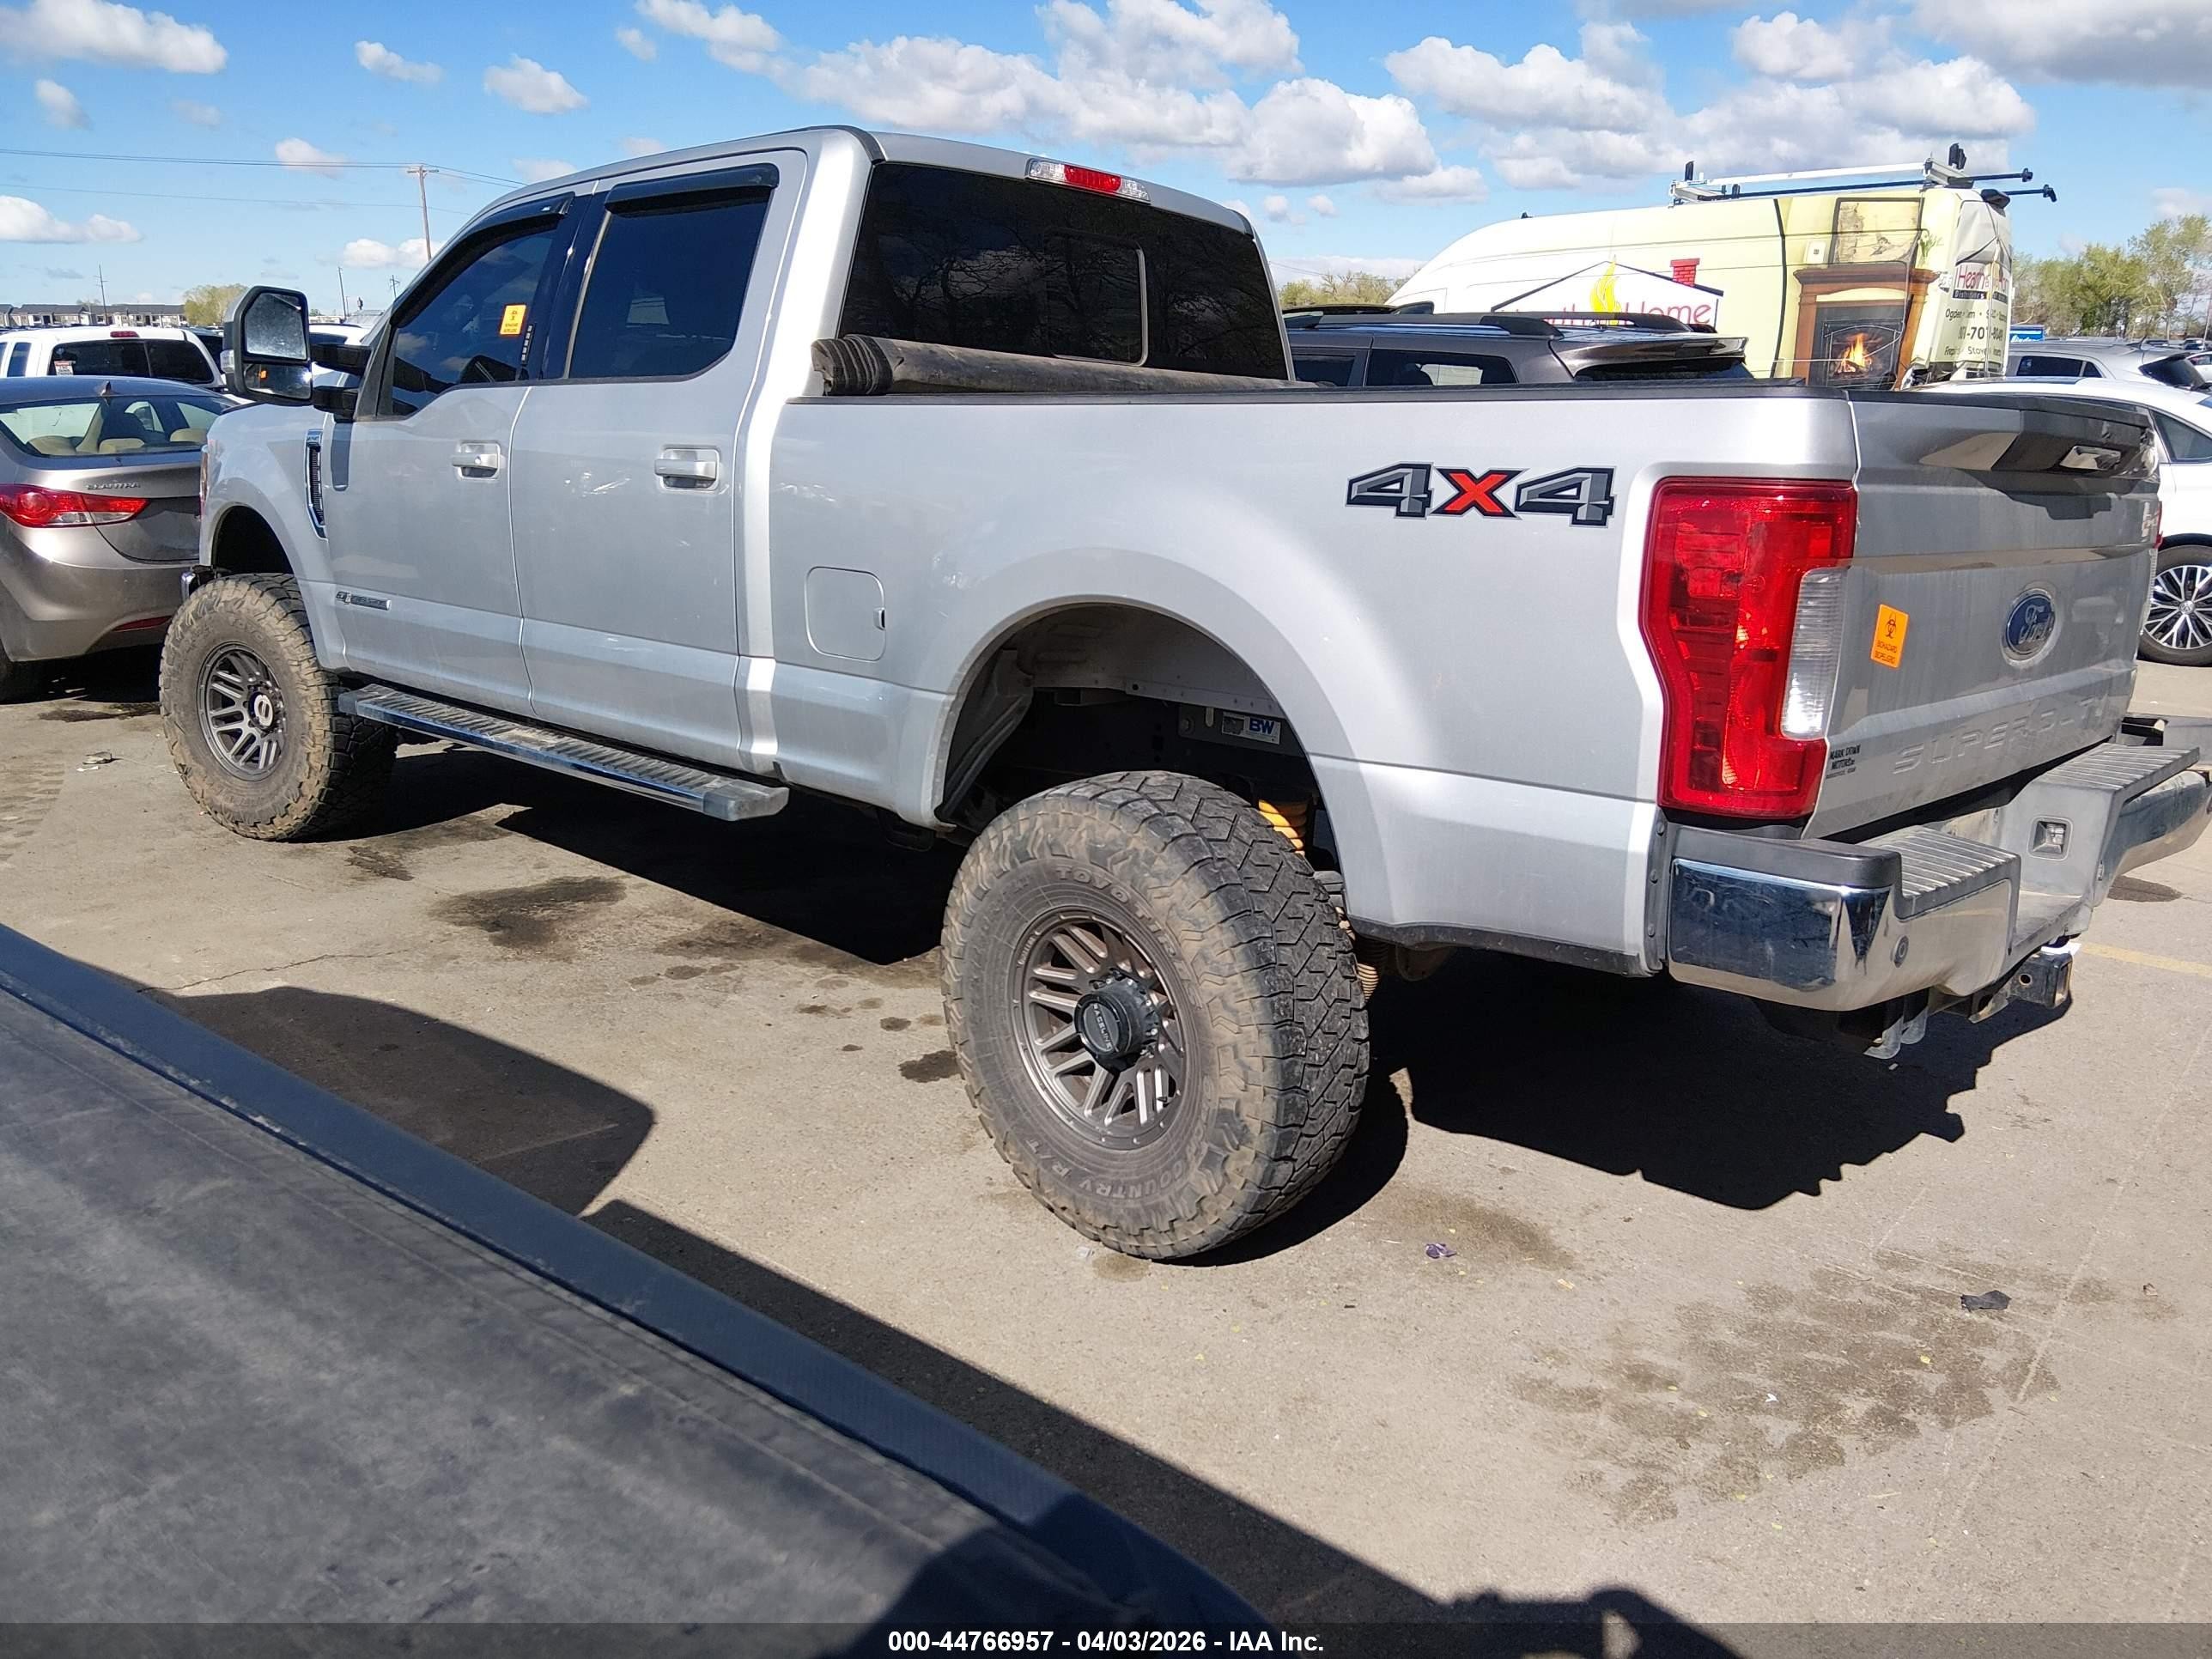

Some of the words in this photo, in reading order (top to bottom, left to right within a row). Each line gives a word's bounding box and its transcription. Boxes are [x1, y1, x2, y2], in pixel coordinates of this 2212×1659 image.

[1346, 462, 1616, 527] 4X4
[2018, 604, 2055, 645] Ford
[1055, 864, 1131, 903] TOYO
